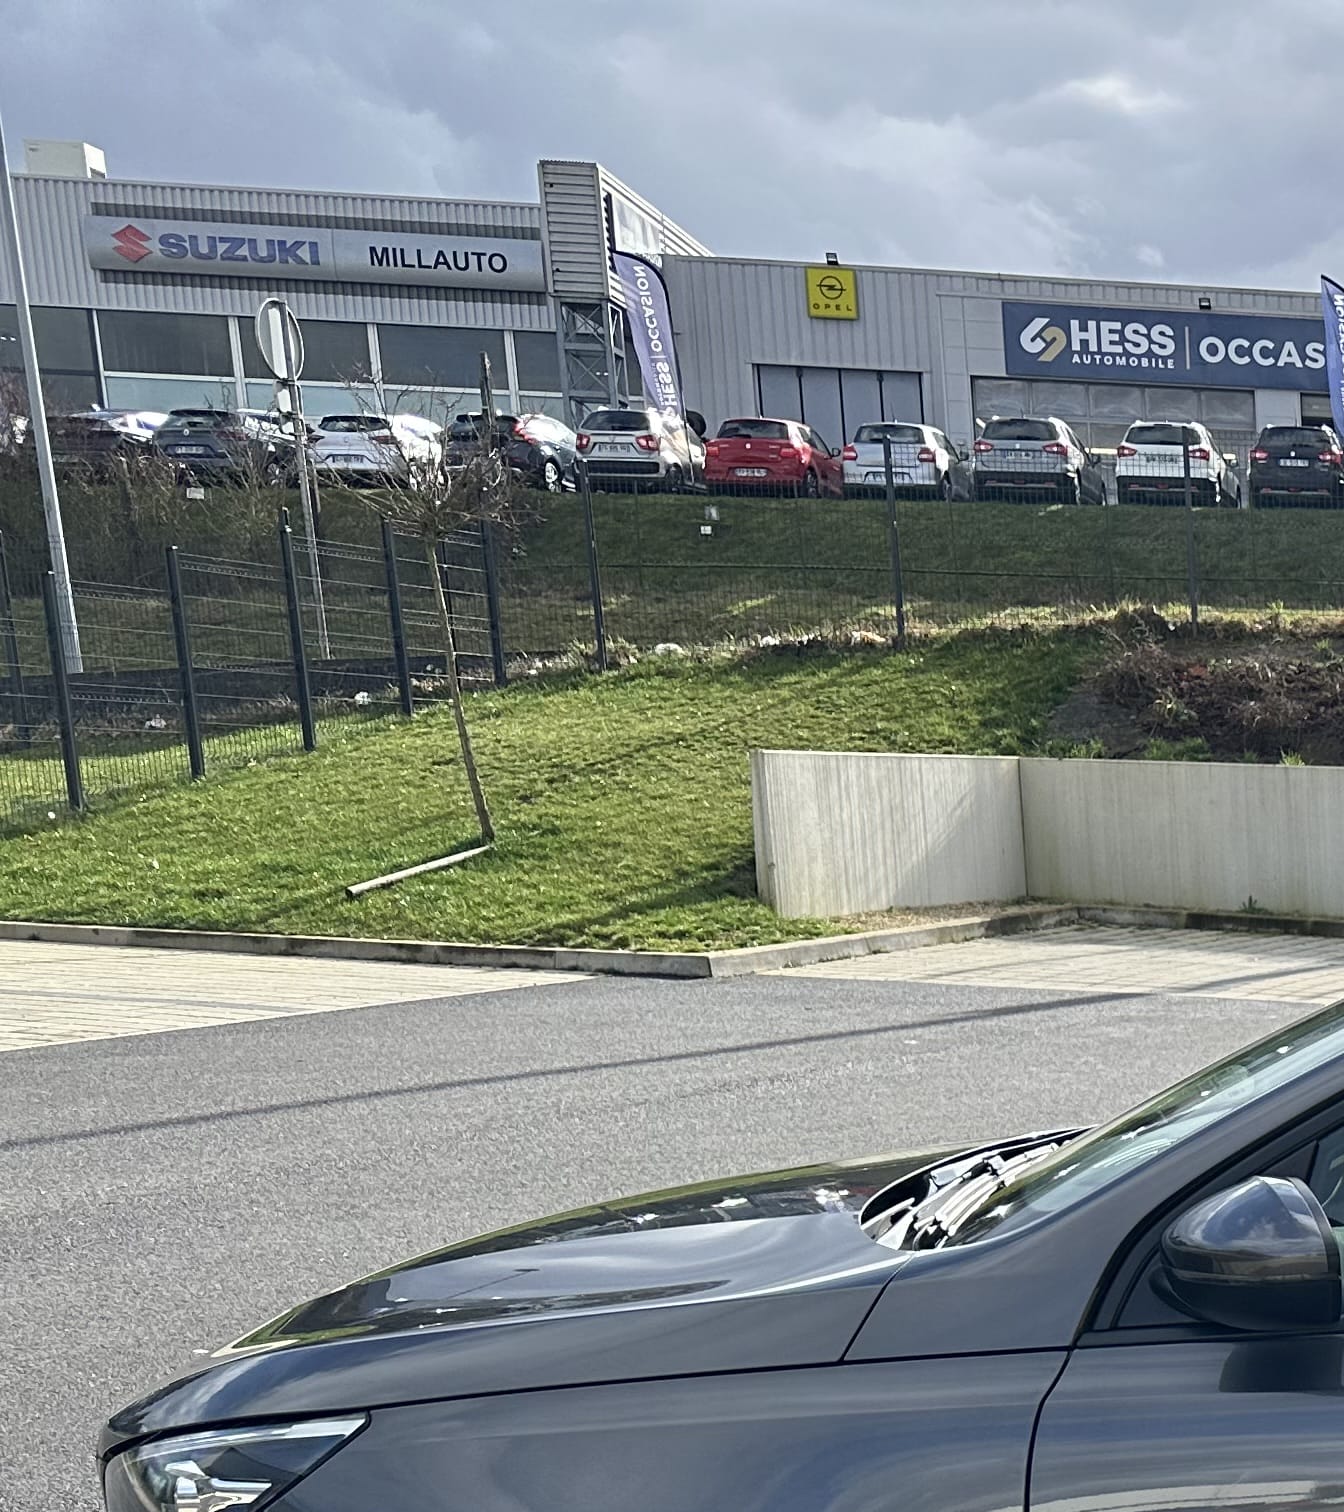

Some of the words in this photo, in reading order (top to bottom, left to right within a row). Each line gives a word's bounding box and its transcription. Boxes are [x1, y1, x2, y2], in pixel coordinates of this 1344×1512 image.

[158, 232, 320, 266] SUZUKI
[369, 245, 508, 274] MILLAUTO
[812, 302, 853, 312] OPEL
[1071, 318, 1176, 356] HESS
[1071, 353, 1176, 369] AUTOMOBILE
